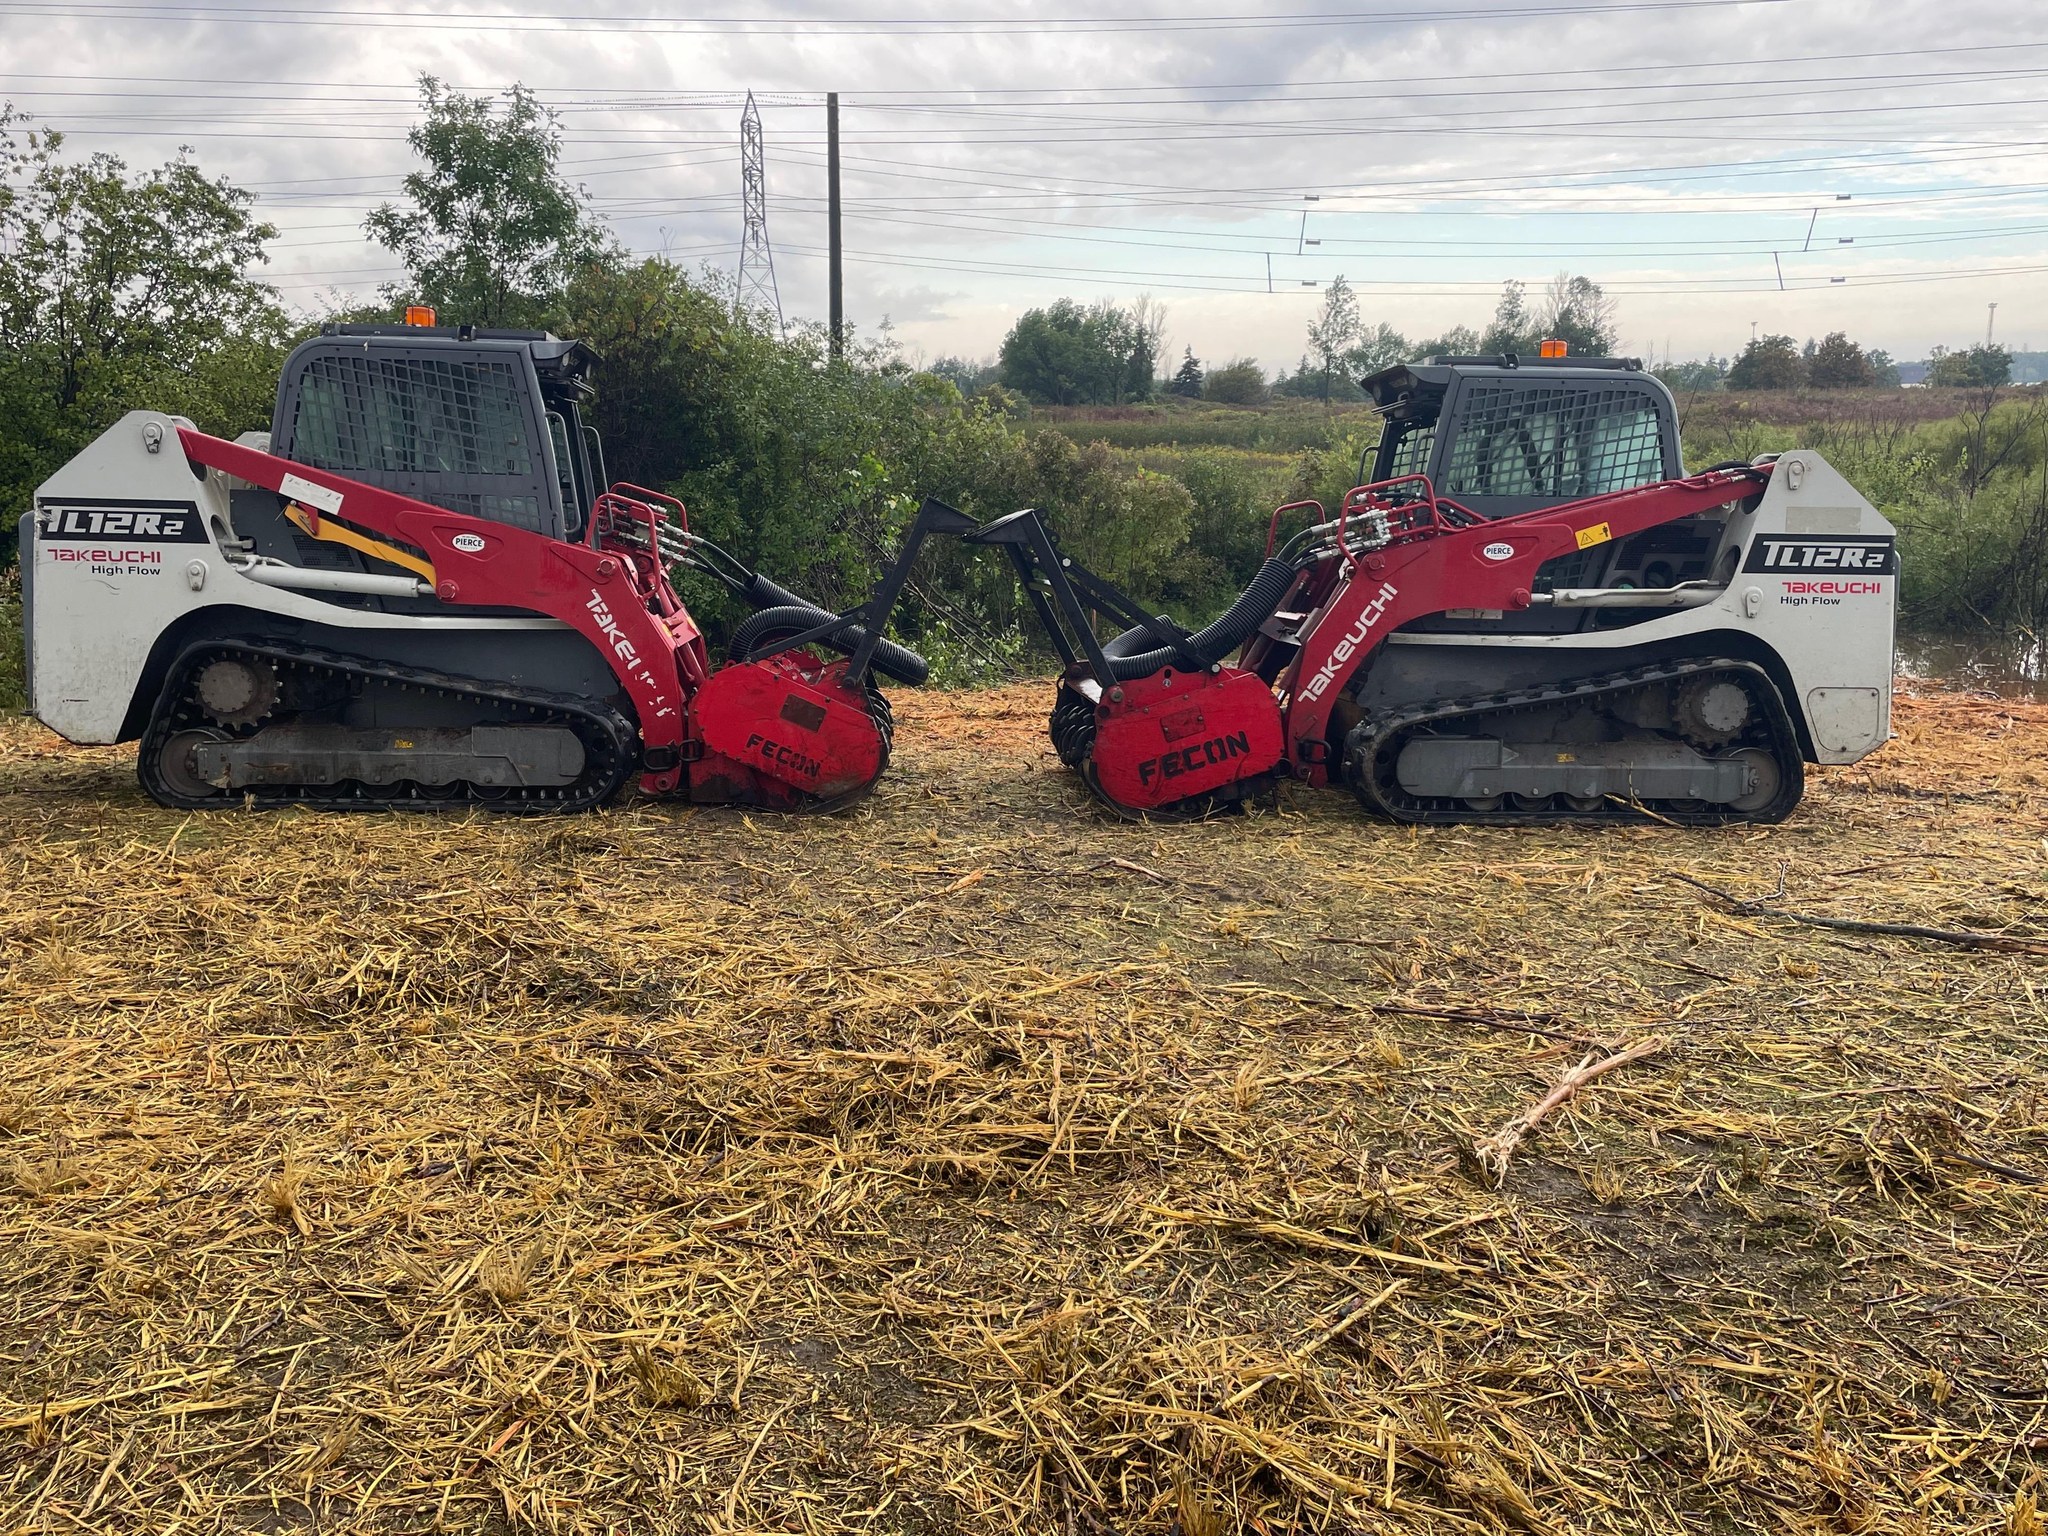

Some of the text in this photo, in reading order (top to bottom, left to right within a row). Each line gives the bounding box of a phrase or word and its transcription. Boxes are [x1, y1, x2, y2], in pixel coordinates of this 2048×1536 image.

[455, 537, 483, 547] PIERCE
[1486, 547, 1512, 555] PIERCE
[1762, 541, 1890, 568] TL12R2
[91, 565, 161, 576] High Flow
[1780, 596, 1841, 606] High Flow
[745, 733, 821, 777] FECON
[1138, 730, 1251, 786] FECON
